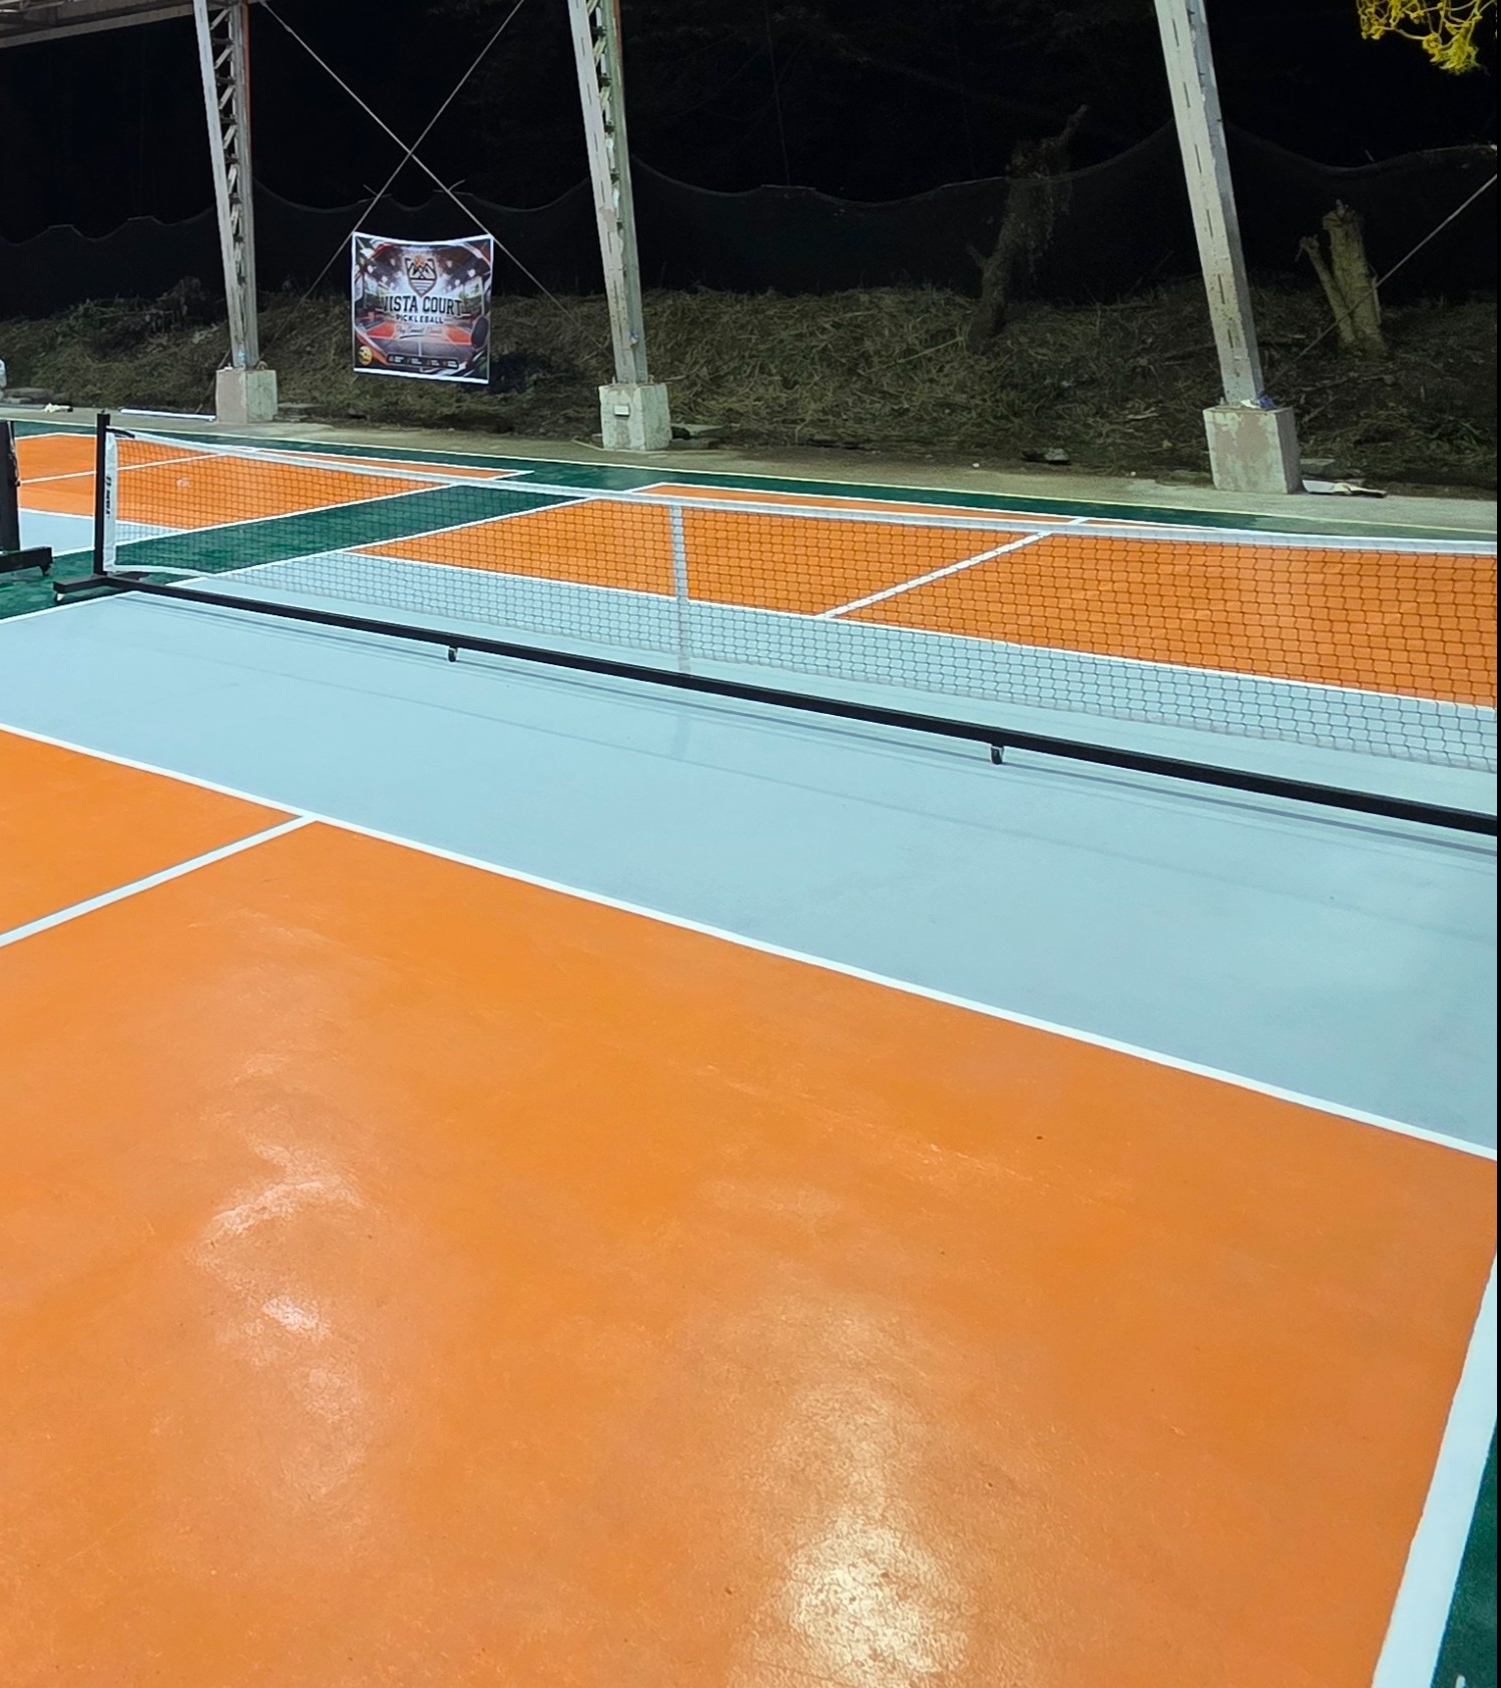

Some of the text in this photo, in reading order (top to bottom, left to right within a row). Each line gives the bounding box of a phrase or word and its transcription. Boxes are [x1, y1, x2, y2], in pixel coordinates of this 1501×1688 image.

[381, 295, 462, 316] VISTA COURT
[396, 314, 444, 324] PICKLEBALL
